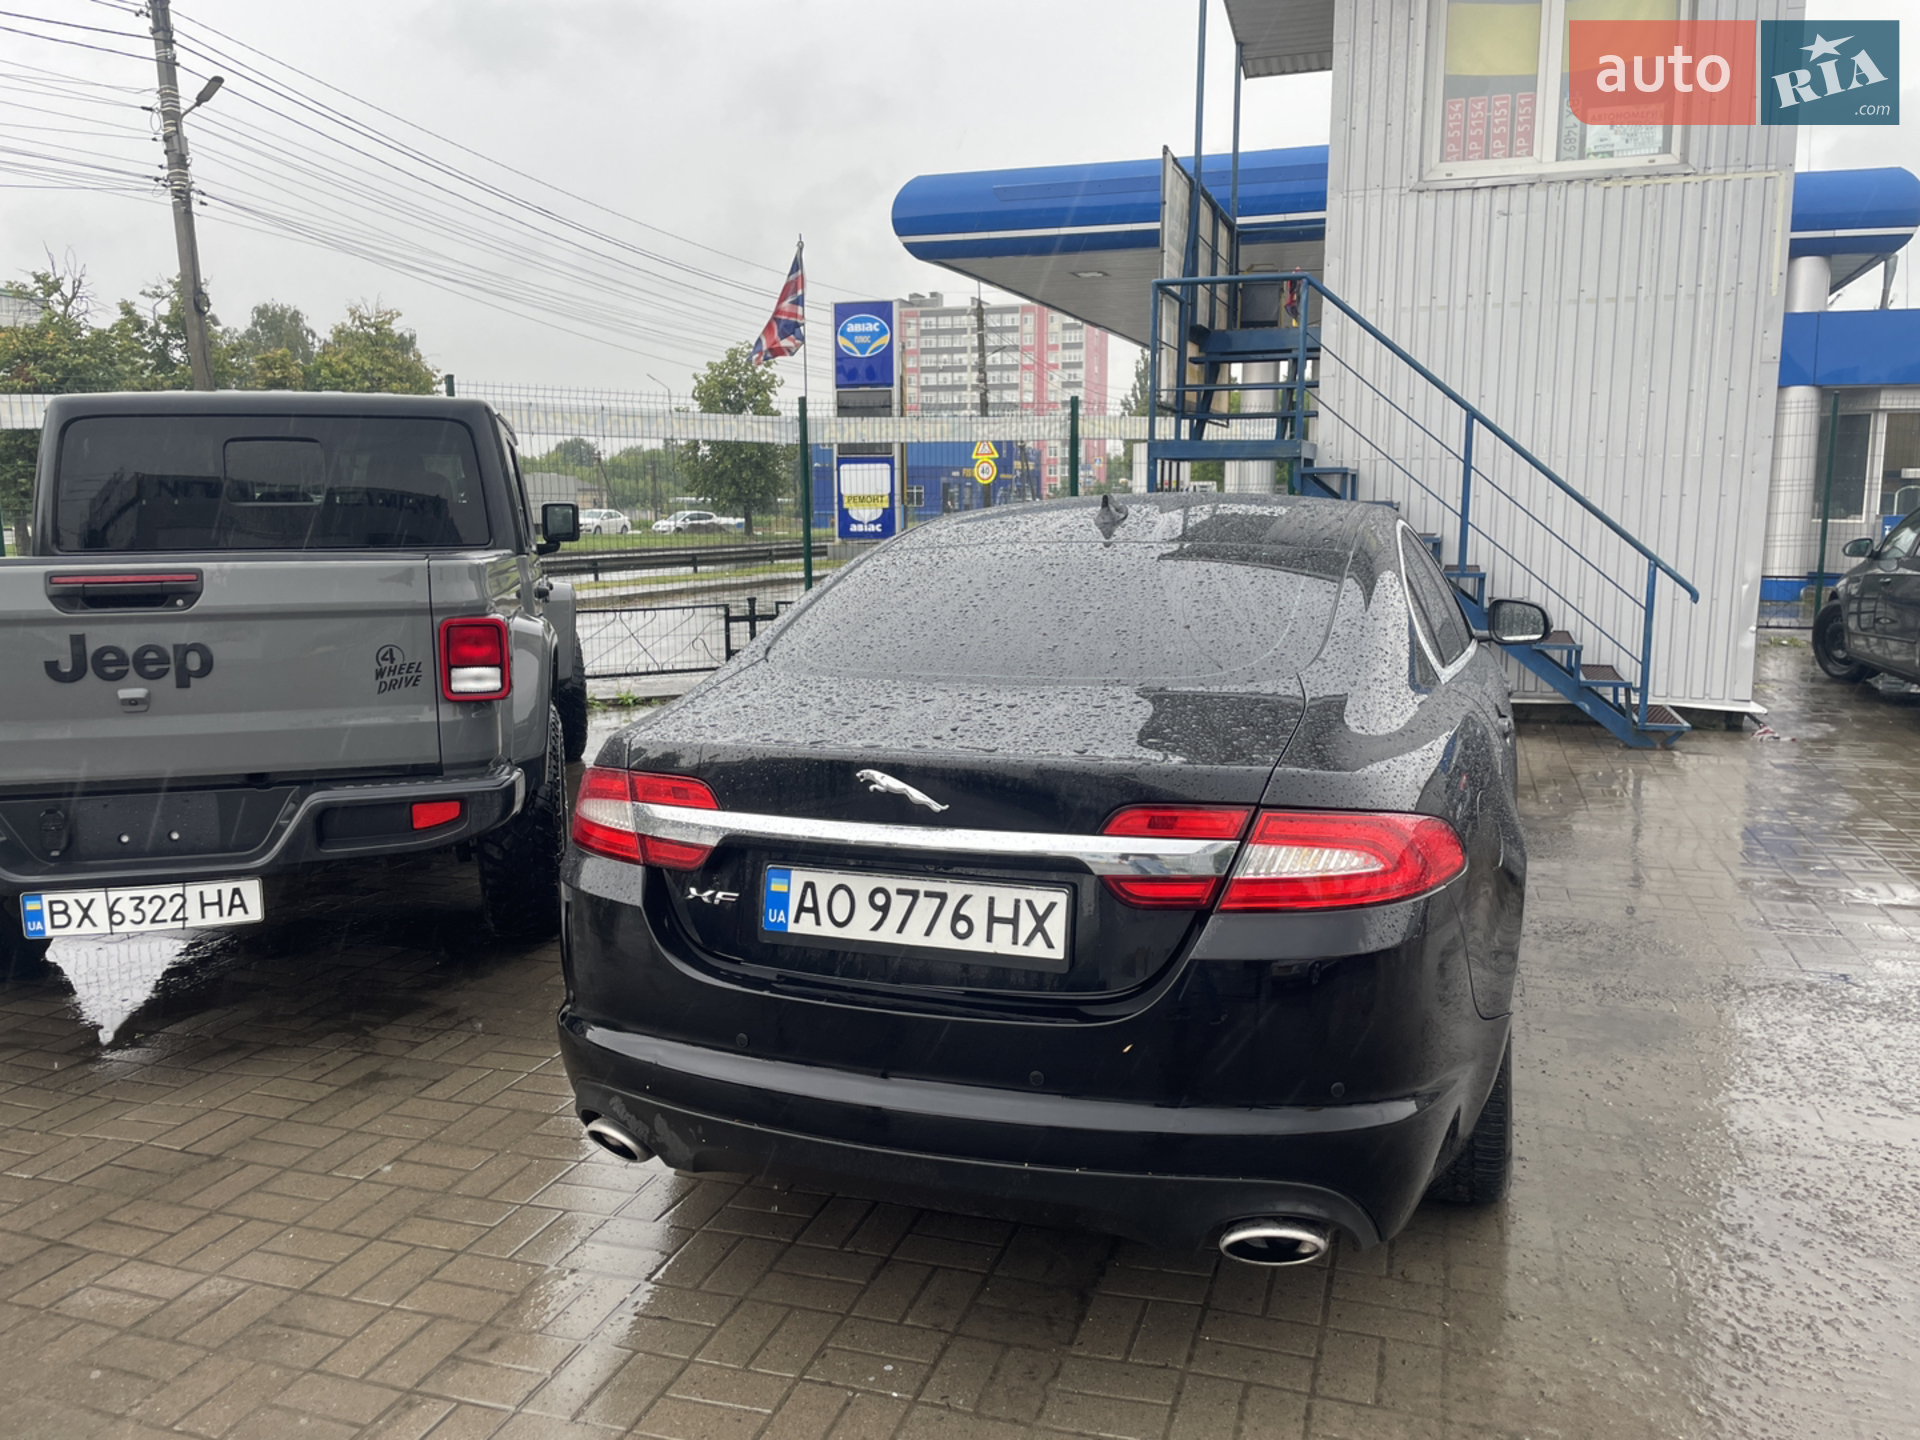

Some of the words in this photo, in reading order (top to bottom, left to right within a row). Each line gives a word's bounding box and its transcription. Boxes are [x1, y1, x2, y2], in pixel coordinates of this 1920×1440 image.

[847, 495, 885, 504] РЕМОНТ
[44, 634, 214, 688] Jeep
[375, 661, 423, 681] WHEEL
[377, 674, 423, 695] DRIVE
[685, 887, 740, 904] XF
[768, 908, 787, 923] UA
[27, 920, 44, 932] UA
